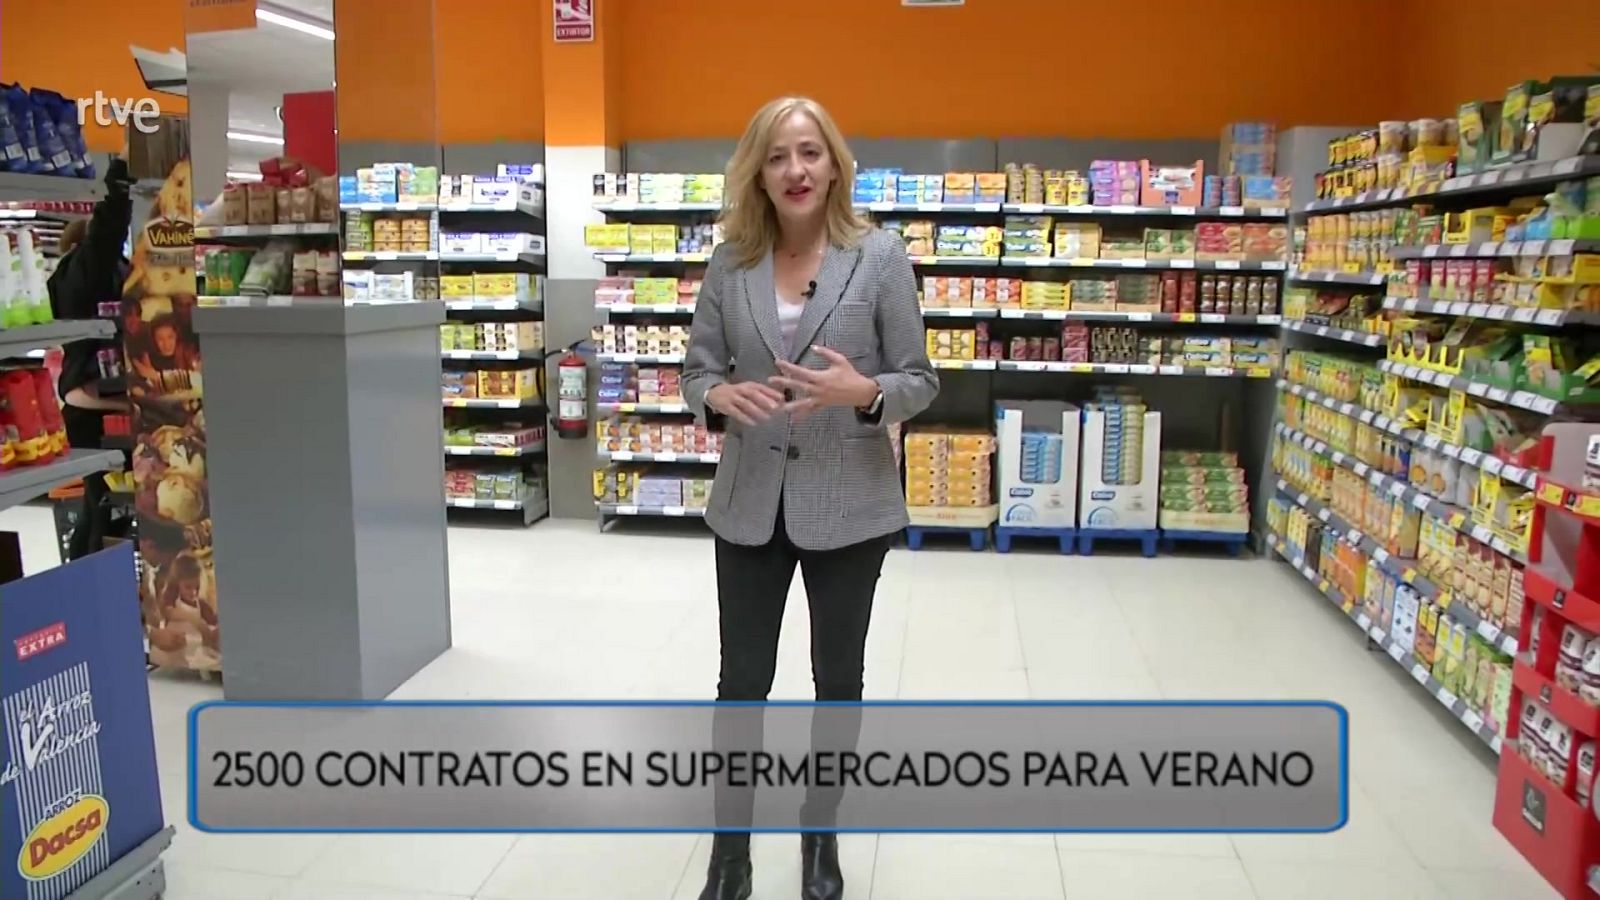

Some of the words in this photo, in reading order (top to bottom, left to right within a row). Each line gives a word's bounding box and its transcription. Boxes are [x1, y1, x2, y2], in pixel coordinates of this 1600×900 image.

[19, 631, 65, 657] EXTRA
[0, 761, 21, 786] de
[20, 719, 101, 771] Valencia
[45, 790, 81, 821] ARROZ
[29, 807, 101, 869] Dacsa
